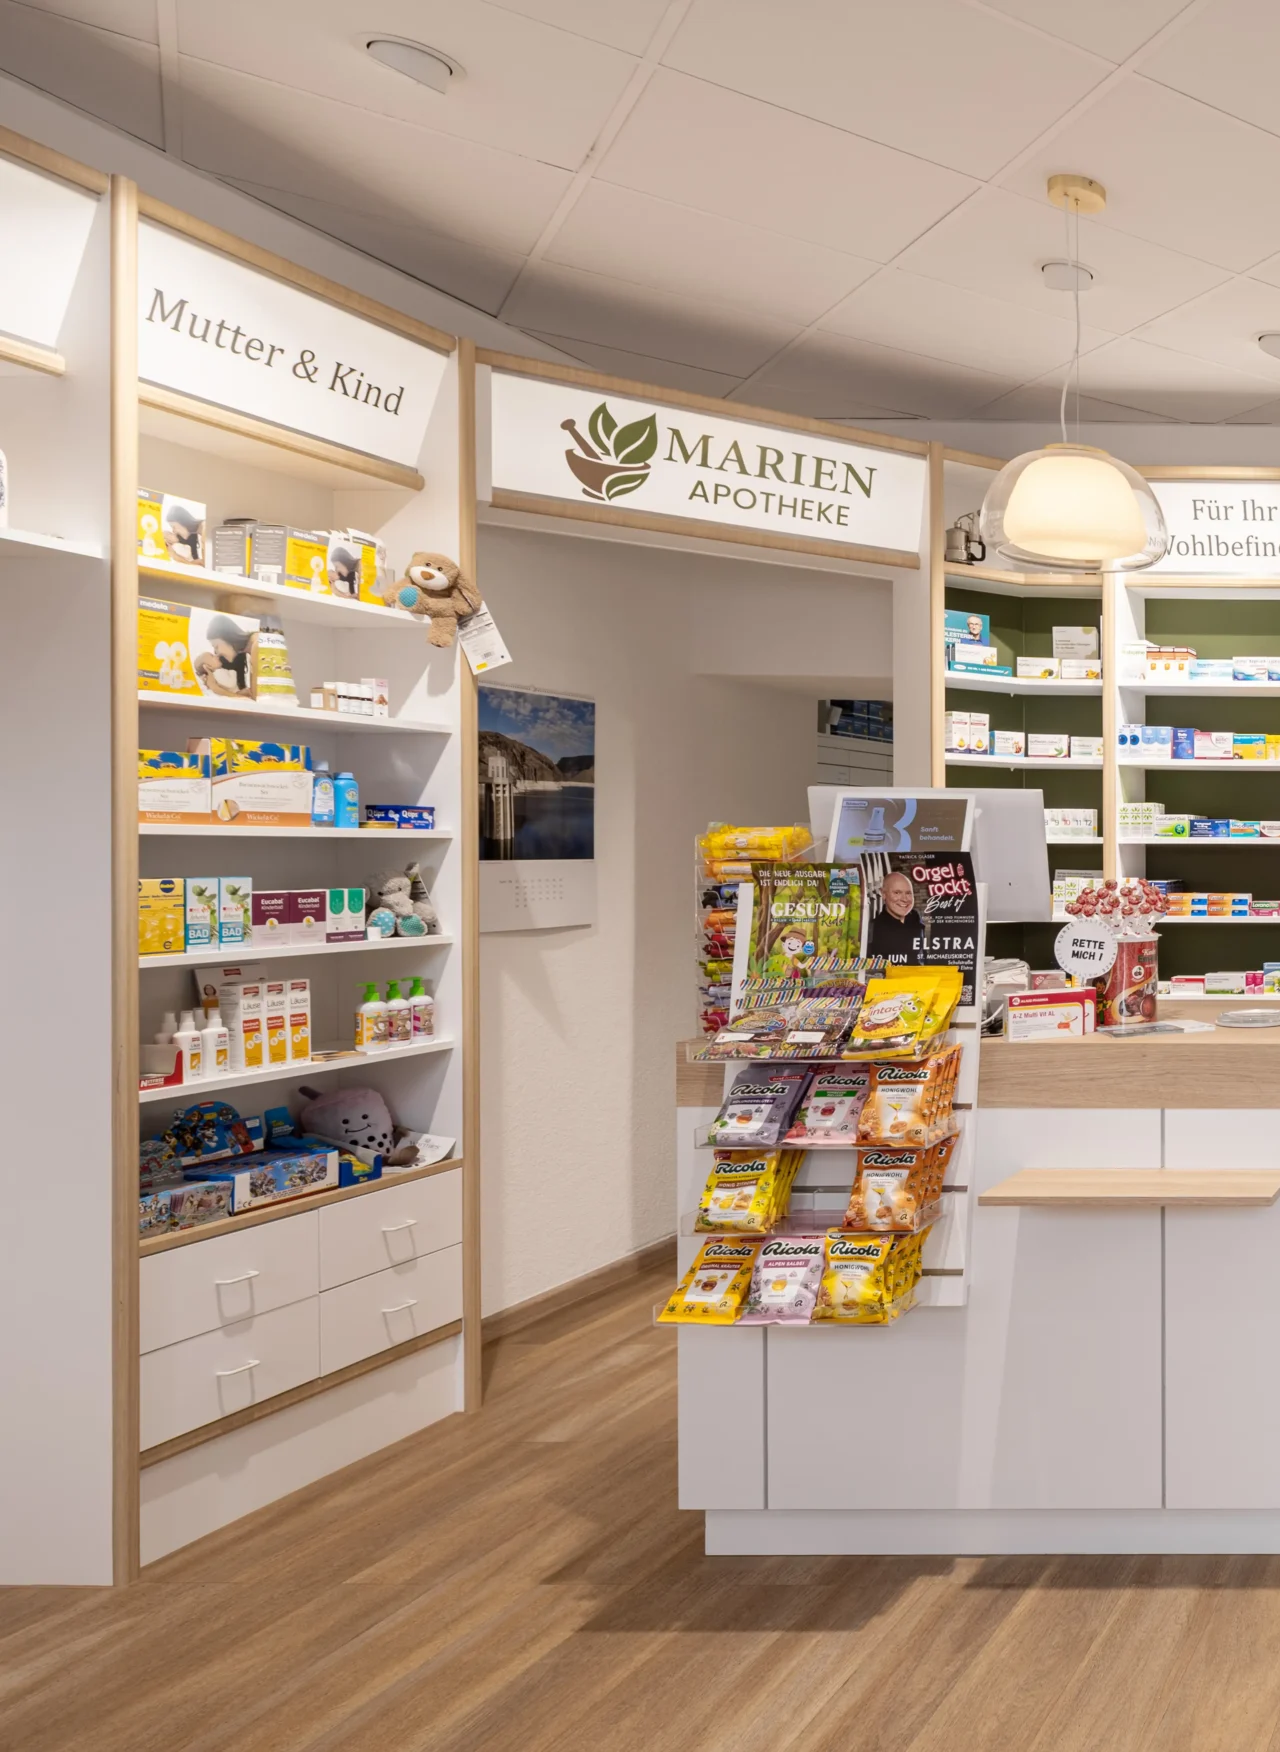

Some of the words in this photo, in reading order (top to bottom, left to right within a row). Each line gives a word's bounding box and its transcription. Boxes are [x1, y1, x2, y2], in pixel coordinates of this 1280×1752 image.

[146, 288, 284, 367] Mutter
[292, 350, 319, 384] &
[328, 362, 405, 416] Kind
[663, 427, 877, 499] MARIEN
[688, 480, 850, 526] APOTHEKE
[1192, 499, 1234, 520] Für
[1241, 499, 1278, 521] Ihr
[1054, 819, 1060, 827] 9
[1062, 819, 1071, 827] 10
[1075, 819, 1082, 827] 11
[1084, 819, 1093, 827] 12
[759, 870, 771, 878] DIE
[912, 864, 955, 882] Orgel
[774, 879, 806, 887] ENDLICH
[810, 879, 820, 887] DA!
[929, 880, 970, 897] rockt
[771, 903, 846, 917] GESUND
[927, 894, 956, 912] Best
[955, 898, 965, 913] of
[821, 914, 844, 927] Kids
[189, 929, 209, 939] BAD
[222, 927, 242, 937] BAD
[912, 937, 975, 950] ELSTRA
[1072, 938, 1105, 950] RETTE
[888, 954, 908, 963] JUN
[1071, 950, 1095, 960] MICH
[870, 1004, 903, 1017] intact
[818, 1074, 868, 1086] Ricola
[878, 1067, 930, 1081] Ricola
[729, 1082, 788, 1097] Ricola
[863, 1153, 916, 1166] Ricola
[715, 1161, 767, 1175] Ricola
[866, 1171, 904, 1179] HONIGWOHL
[705, 1244, 754, 1258] Ricola
[762, 1242, 821, 1256] Ricola
[830, 1242, 882, 1257] Ricola
